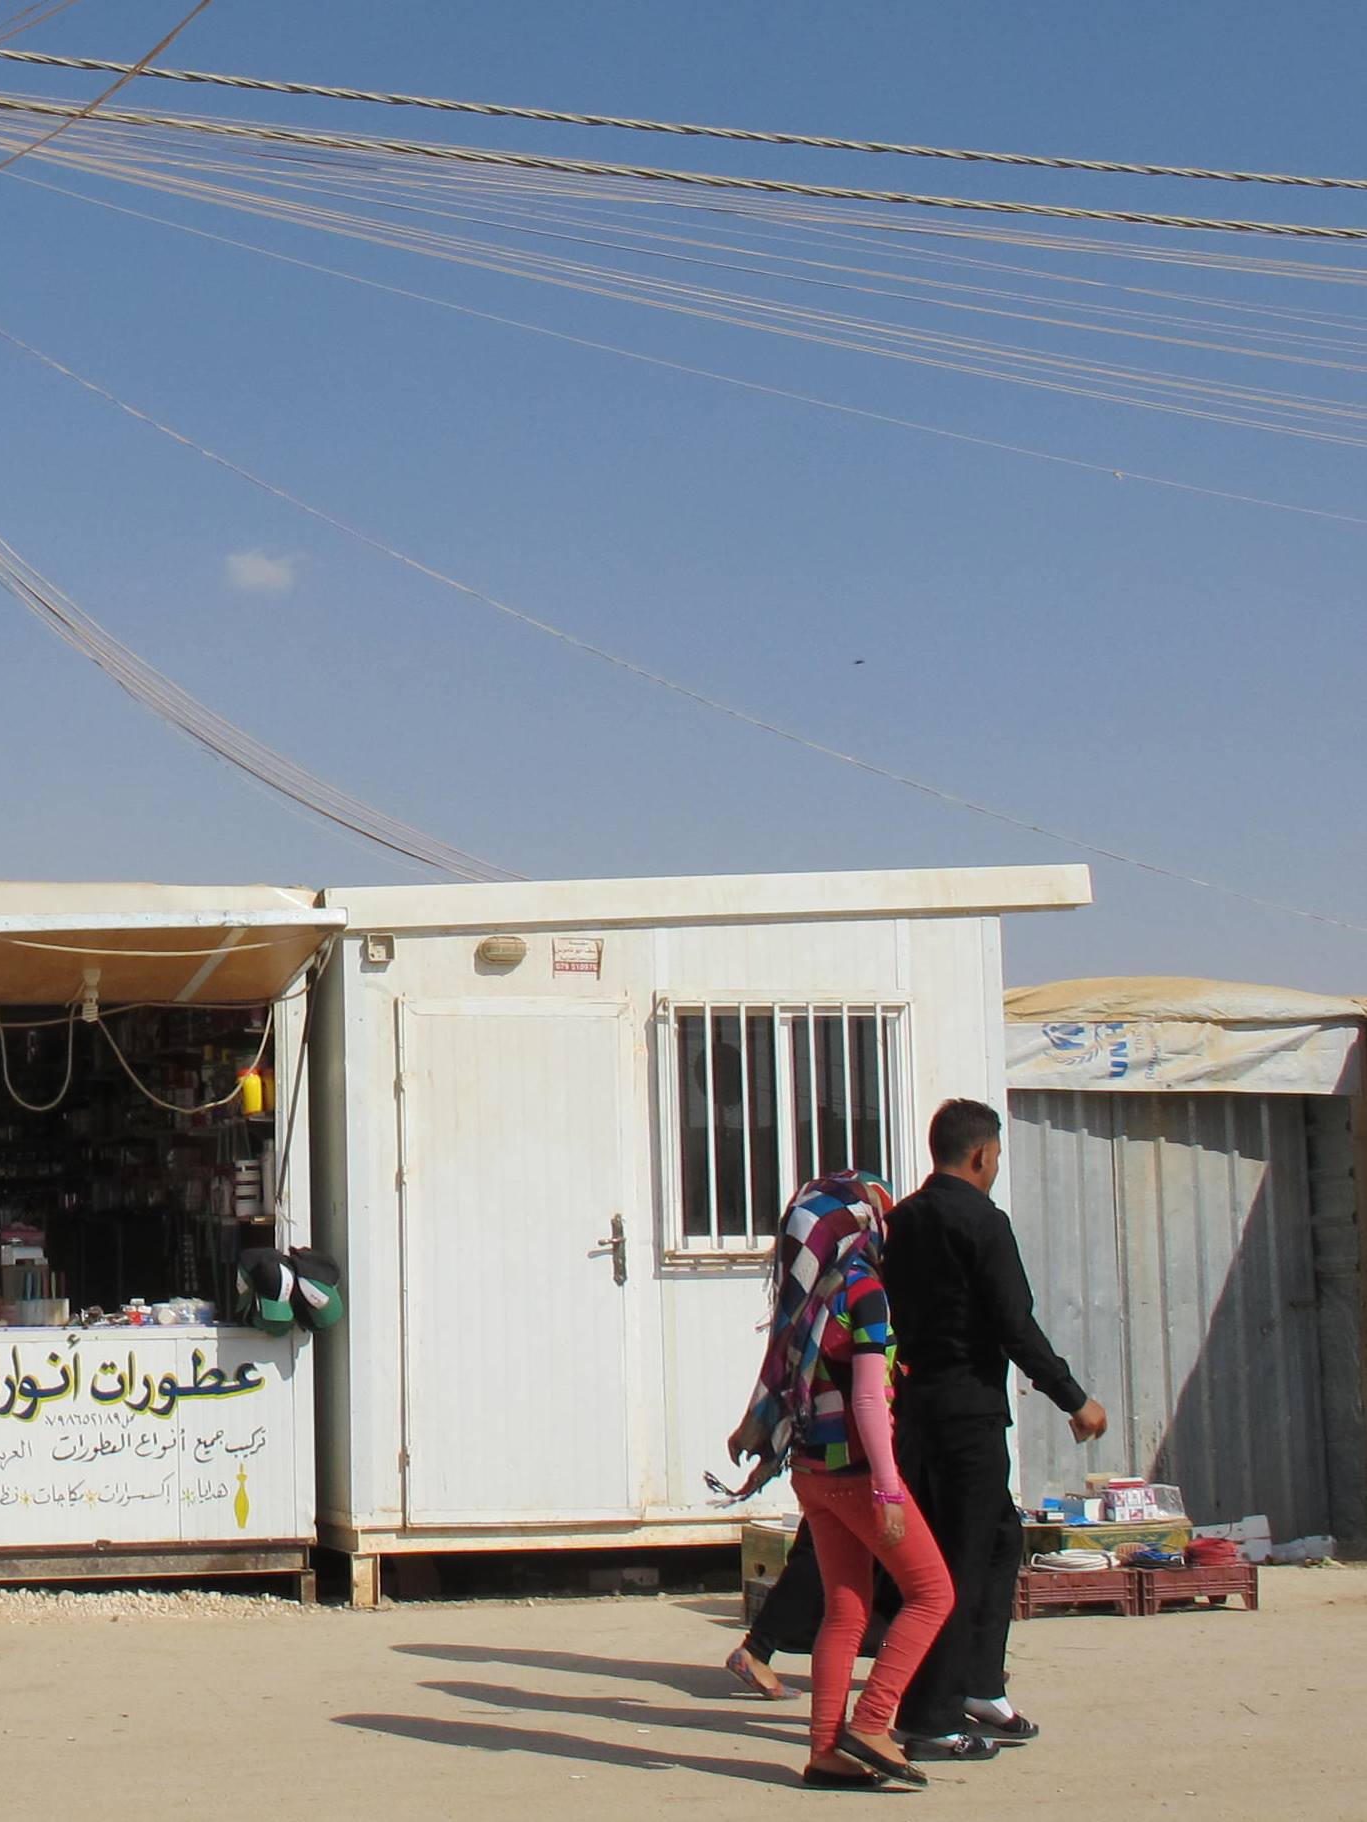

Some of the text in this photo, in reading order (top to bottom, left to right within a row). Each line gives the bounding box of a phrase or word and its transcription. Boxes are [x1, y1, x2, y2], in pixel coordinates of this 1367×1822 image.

[90, 1349, 266, 1417] عطورات
[51, 1431, 132, 1462] العطورات
[135, 1428, 186, 1460] أنواع
[194, 1429, 224, 1463] جميع
[224, 1426, 266, 1460] تركيب
